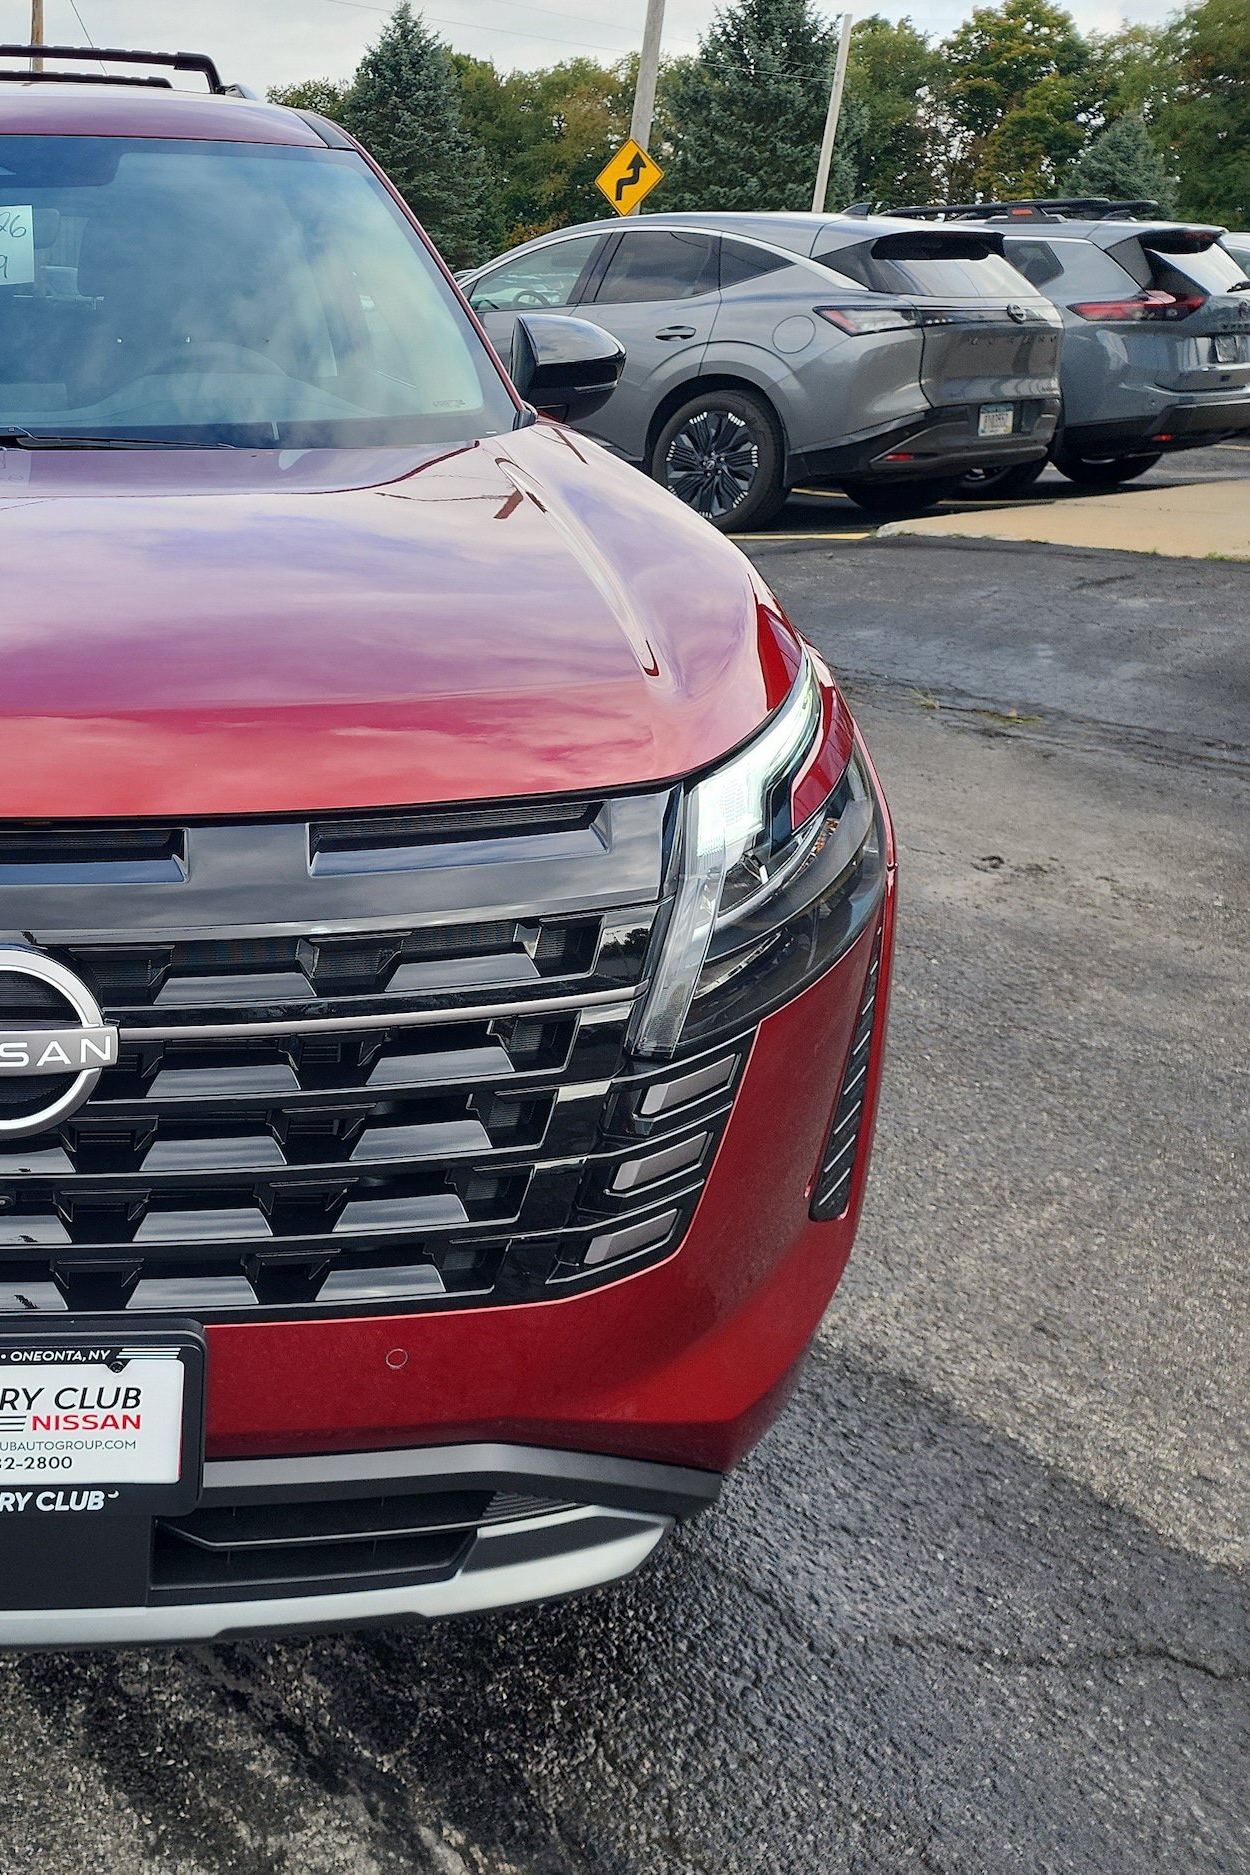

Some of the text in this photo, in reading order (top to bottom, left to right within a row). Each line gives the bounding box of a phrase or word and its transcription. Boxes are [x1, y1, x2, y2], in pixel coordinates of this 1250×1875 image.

[54, 1387, 142, 1410] CLUB
[32, 1414, 141, 1431] NISSAN
[35, 1490, 106, 1512] CLUB
